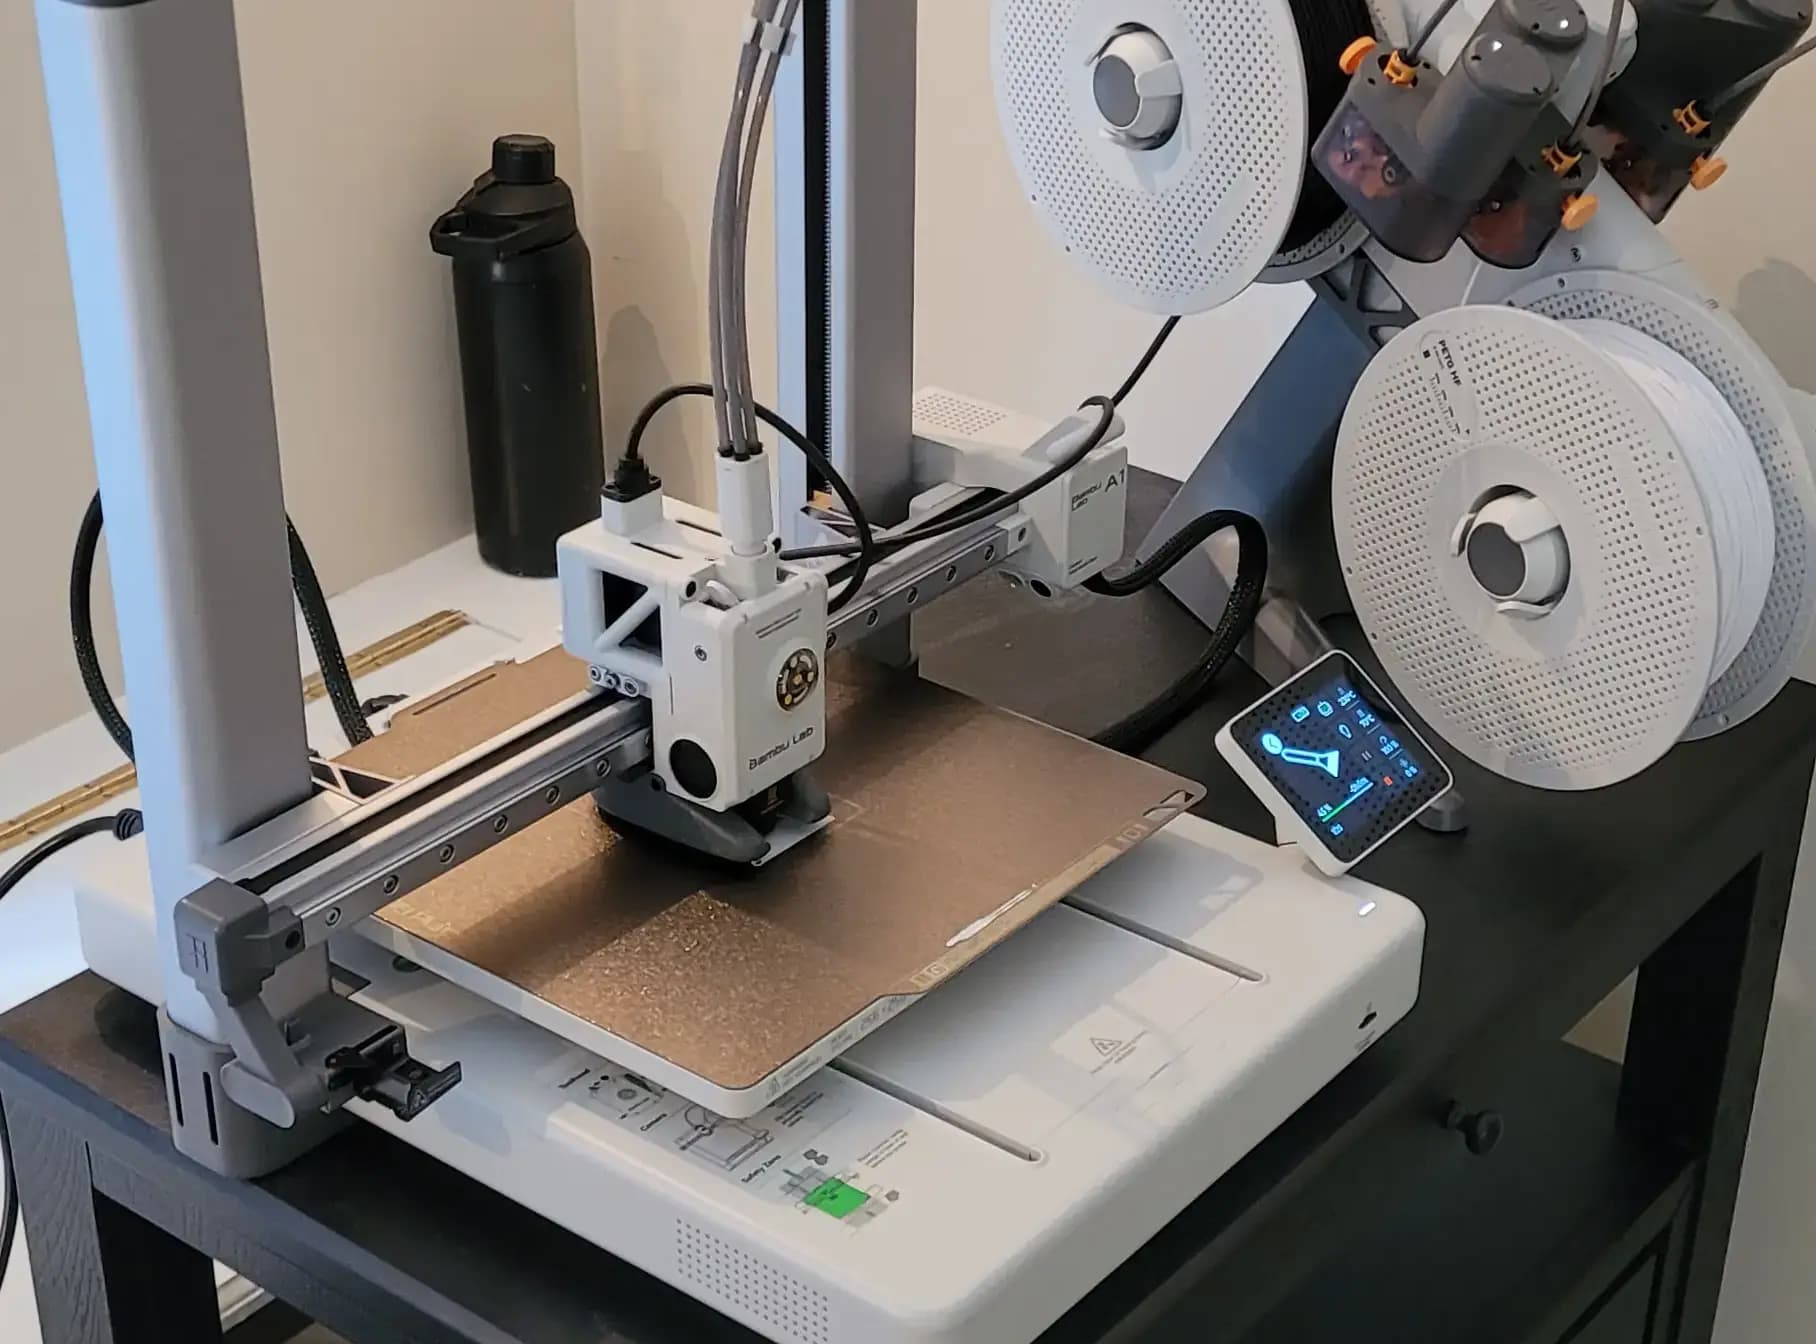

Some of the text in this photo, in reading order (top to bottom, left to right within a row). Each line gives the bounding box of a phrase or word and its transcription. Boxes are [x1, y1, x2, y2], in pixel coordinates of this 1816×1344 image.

[1104, 468, 1125, 493] A1
[749, 726, 814, 771] Bambu Lab
